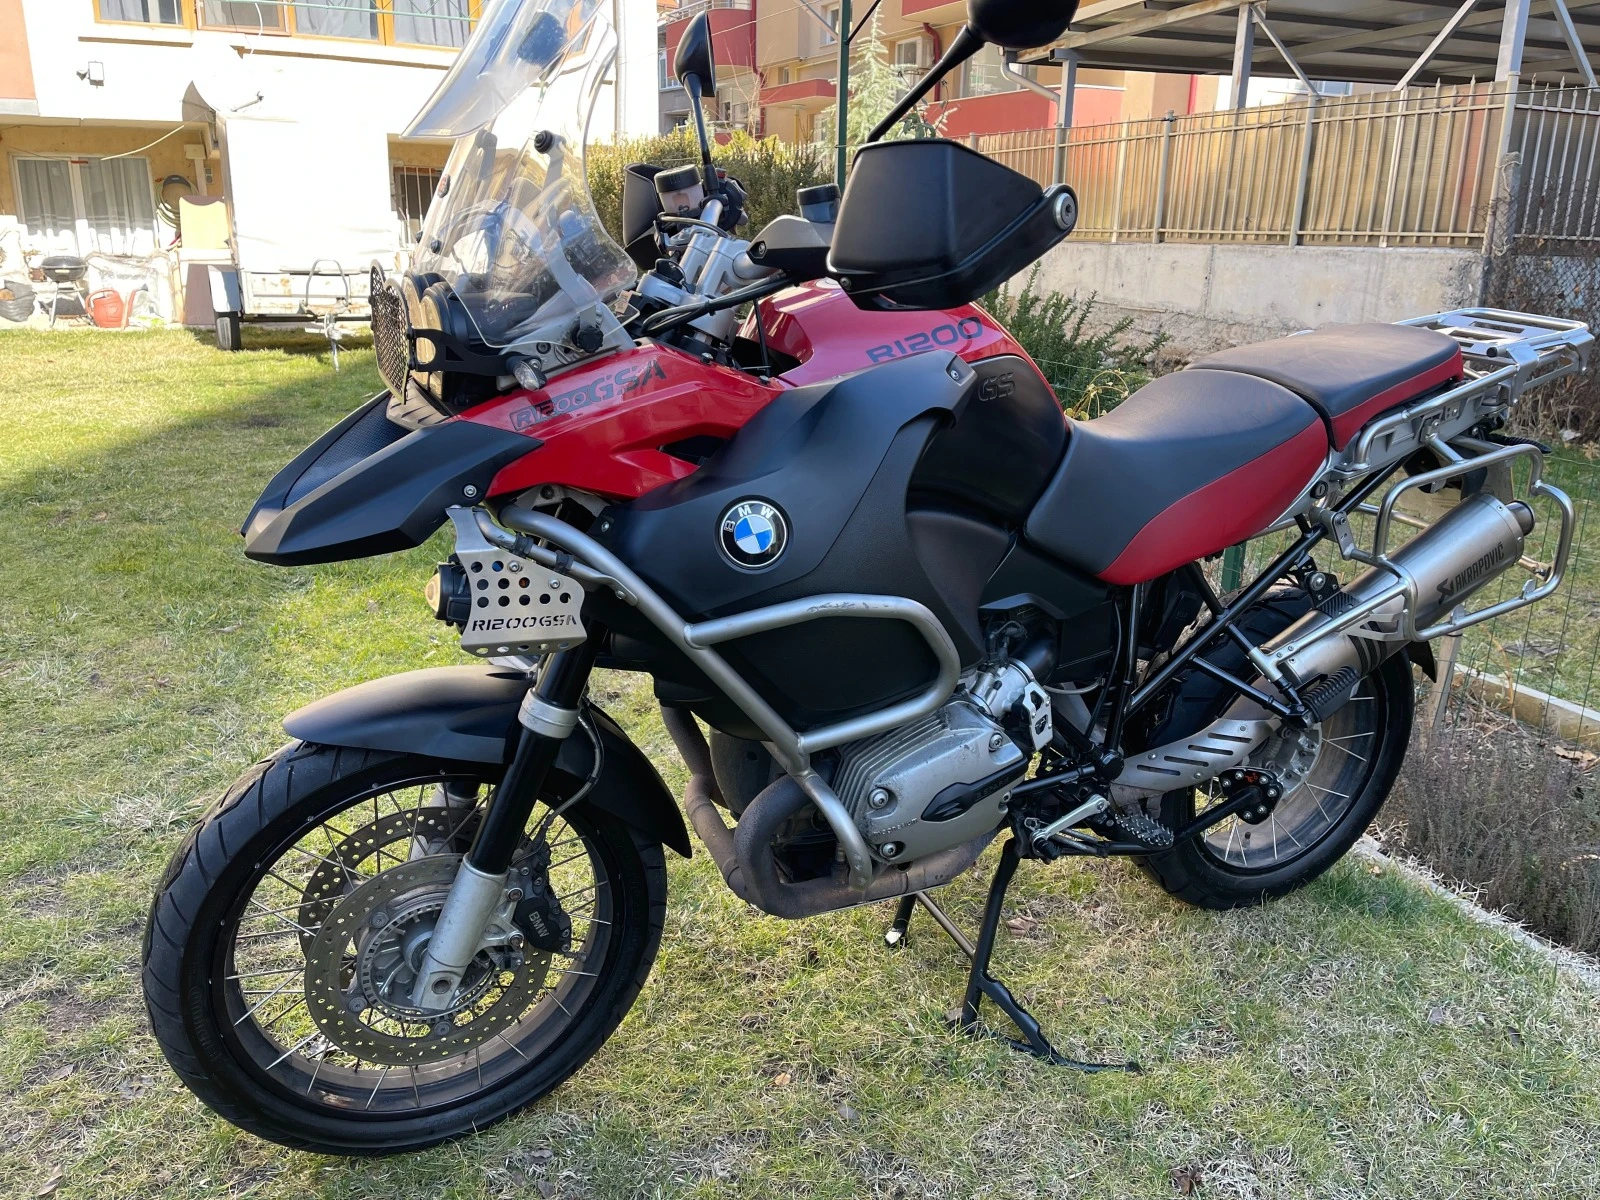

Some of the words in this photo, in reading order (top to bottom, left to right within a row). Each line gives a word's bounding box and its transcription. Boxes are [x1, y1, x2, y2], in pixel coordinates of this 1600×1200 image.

[865, 316, 983, 363] R1200
[978, 372, 1016, 402] GS
[723, 504, 774, 533] BMW
[472, 614, 577, 632] R1200GSA
[528, 911, 550, 938] BMW
